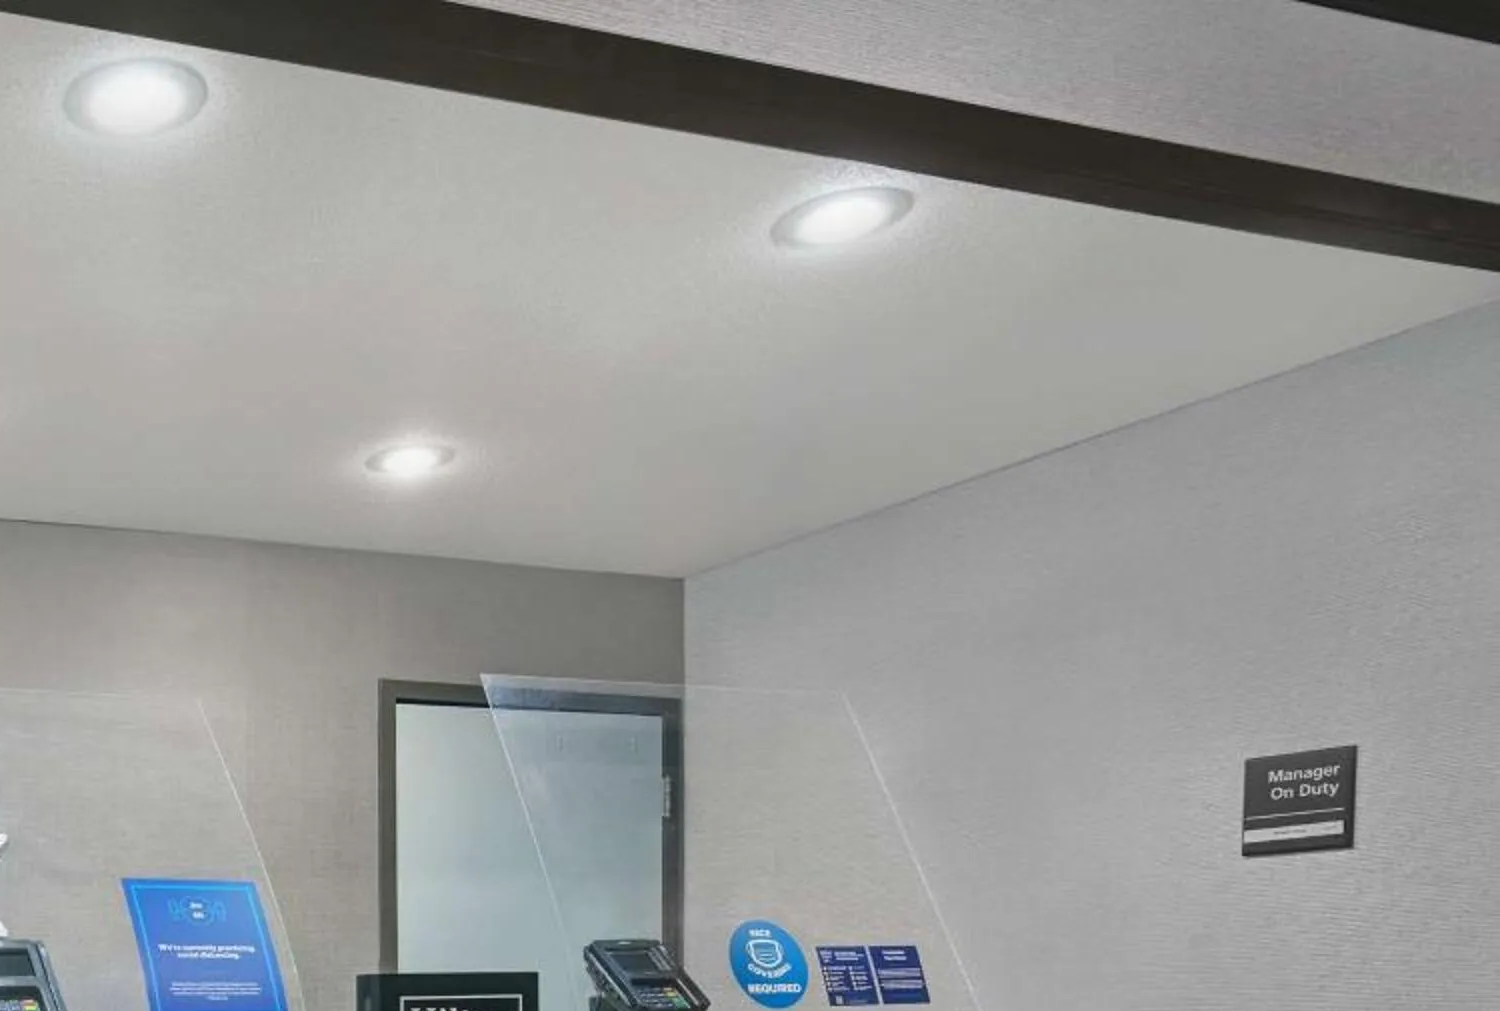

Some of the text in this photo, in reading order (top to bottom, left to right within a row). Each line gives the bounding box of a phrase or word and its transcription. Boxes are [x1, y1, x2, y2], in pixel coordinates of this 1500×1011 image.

[1268, 765, 1341, 782] Manager
[1270, 783, 1340, 800] On Duty
[747, 983, 802, 994] REQUIRED
